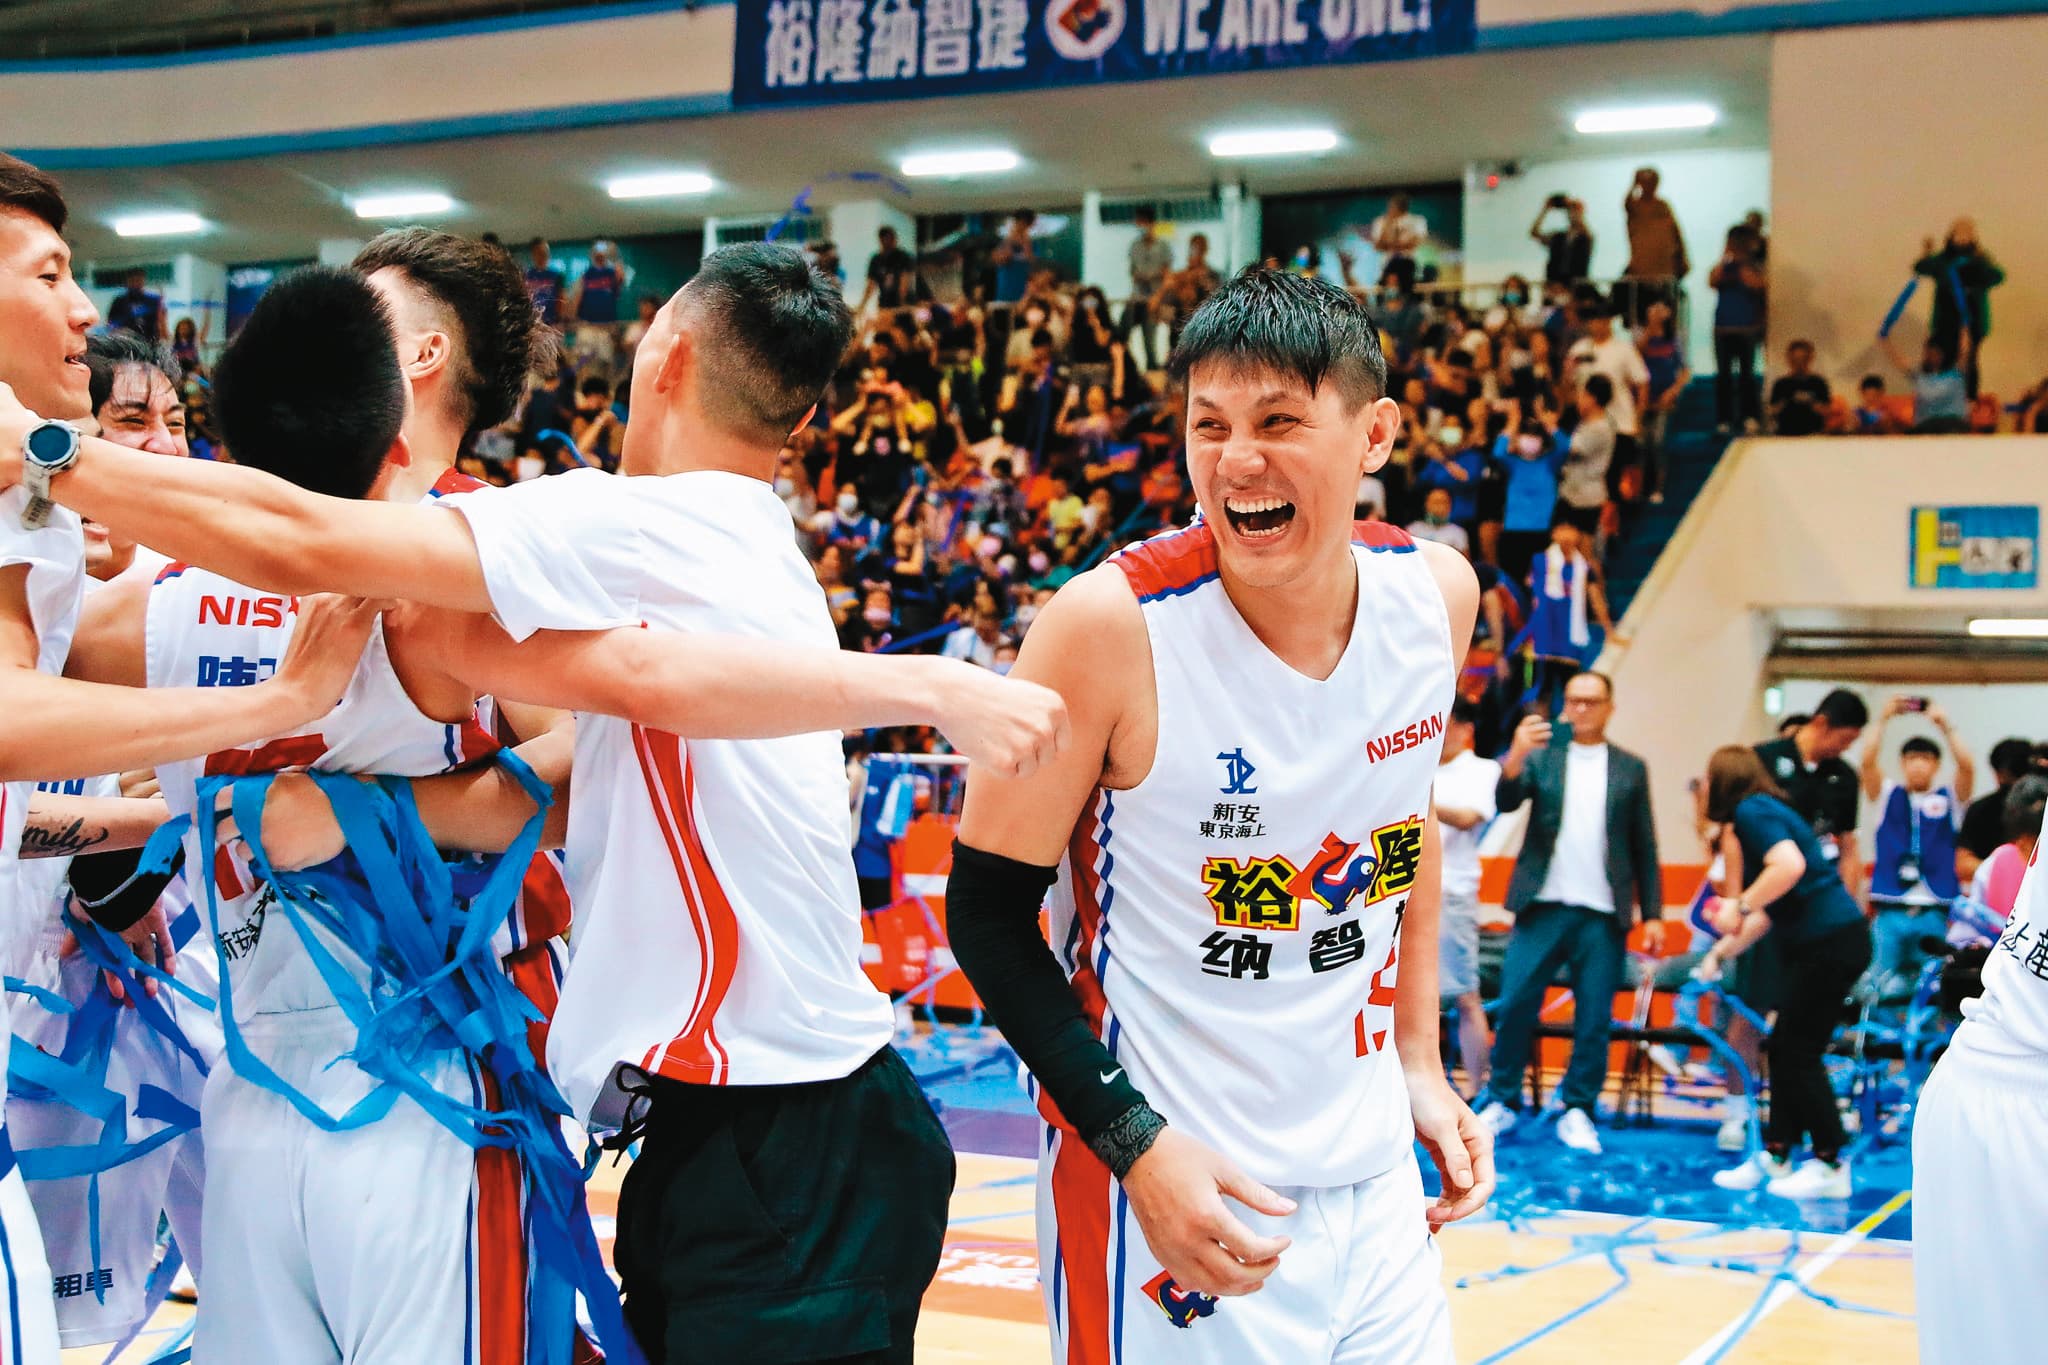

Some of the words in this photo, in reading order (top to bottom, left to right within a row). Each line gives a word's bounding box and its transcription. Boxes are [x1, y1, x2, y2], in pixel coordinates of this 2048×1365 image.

[1365, 711, 1443, 764] NISSAN
[1212, 802, 1260, 824] 新安
[1199, 820, 1267, 840] 東京海上
